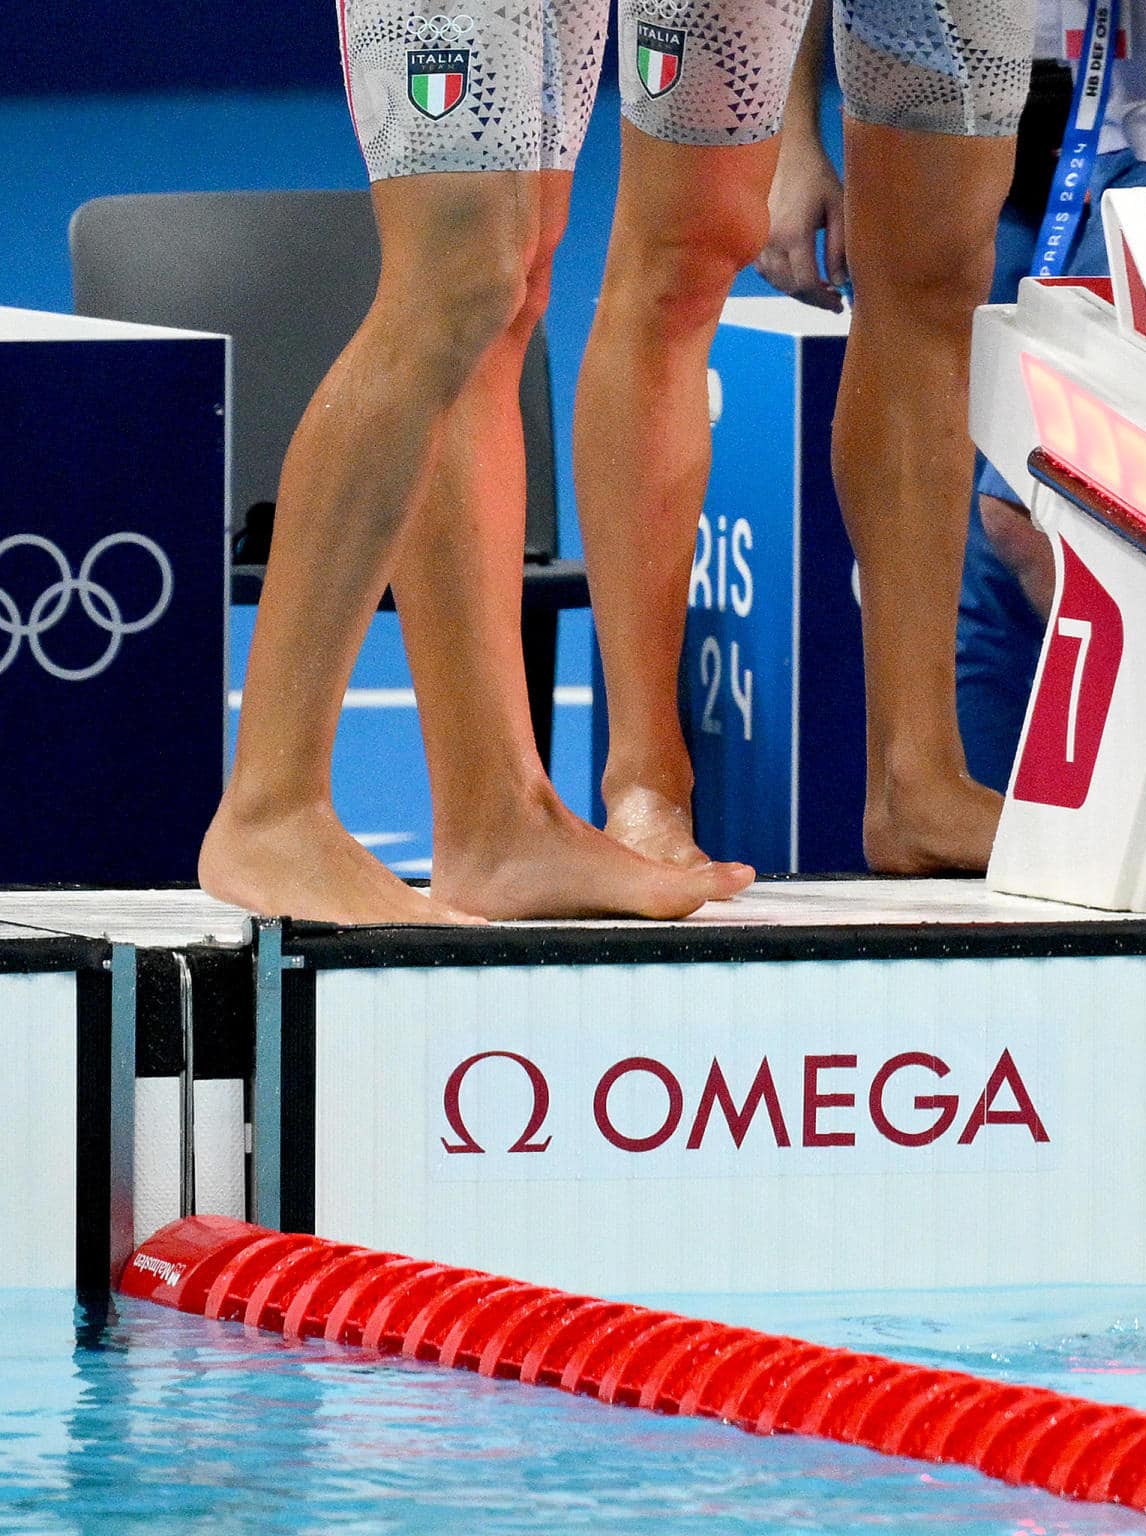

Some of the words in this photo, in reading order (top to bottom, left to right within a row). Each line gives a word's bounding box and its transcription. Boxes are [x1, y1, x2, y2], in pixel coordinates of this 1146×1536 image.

[638, 24, 681, 46] ITALIA
[1090, 41, 1105, 71] DEF
[411, 53, 465, 65] ITALIA
[1058, 142, 1088, 203] 2024
[1057, 616, 1093, 763] 7
[592, 1046, 1052, 1153] OMEGA
